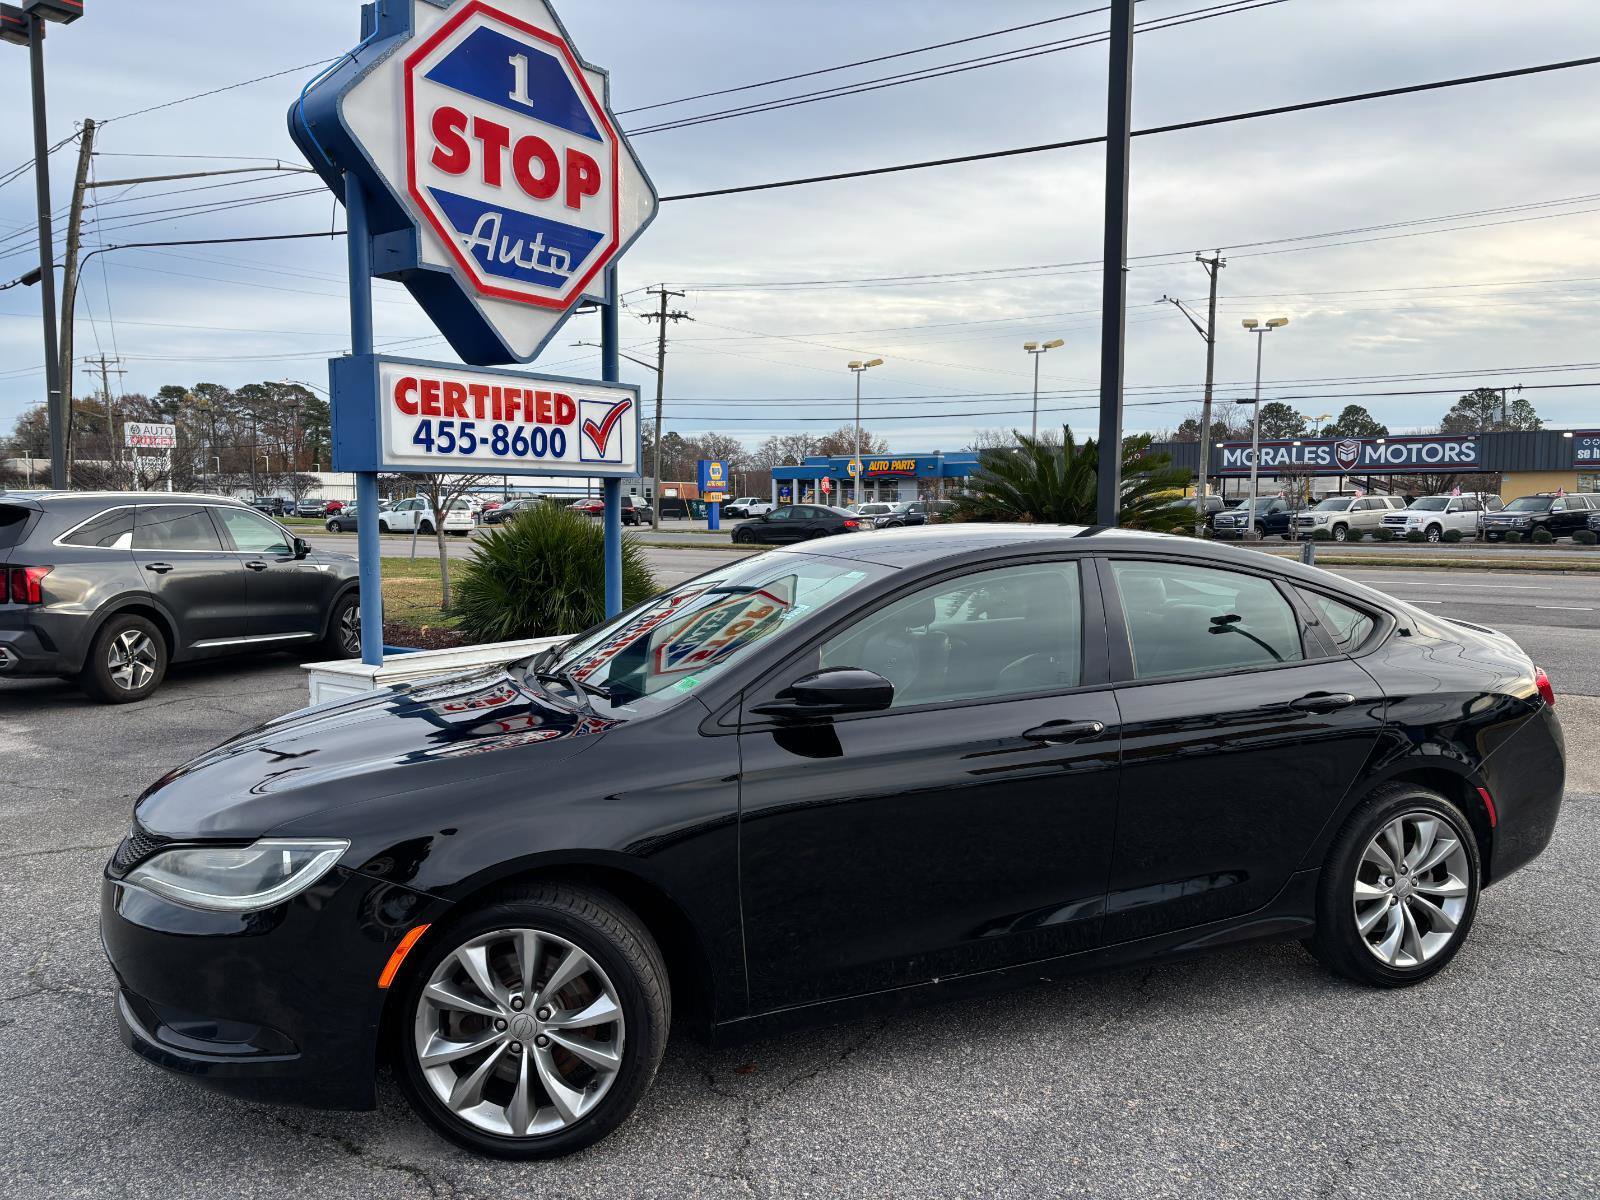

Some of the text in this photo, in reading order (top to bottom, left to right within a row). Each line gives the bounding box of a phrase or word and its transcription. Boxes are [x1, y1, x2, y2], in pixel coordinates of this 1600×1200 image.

[508, 53, 534, 107] 1
[431, 106, 602, 211] STOP
[461, 212, 571, 278] Auto
[394, 376, 577, 426] CERTIFIED
[143, 426, 173, 436] AUTO
[412, 419, 567, 459] 455-8600
[868, 460, 889, 471] AUTO
[890, 459, 916, 470] PARTS
[1223, 442, 1476, 467] MORALES MOTORS
